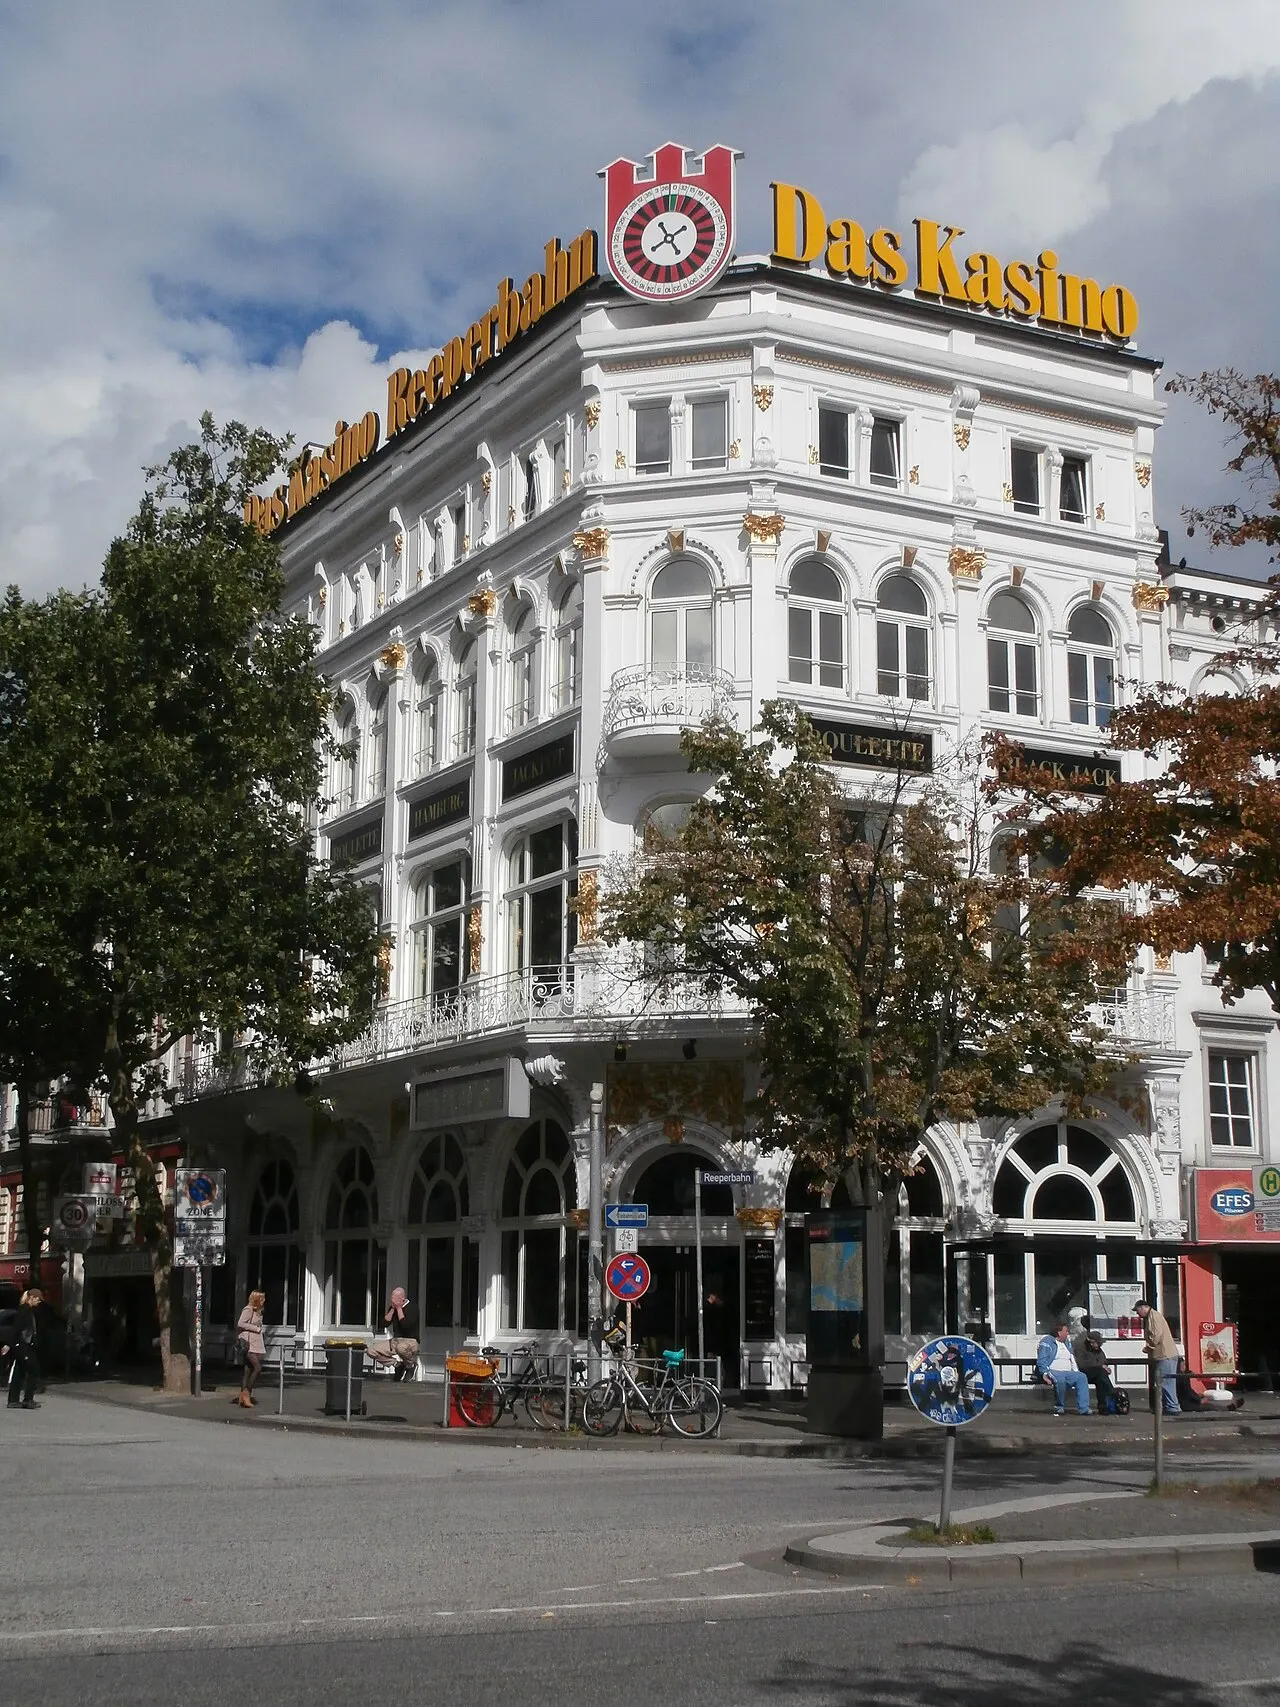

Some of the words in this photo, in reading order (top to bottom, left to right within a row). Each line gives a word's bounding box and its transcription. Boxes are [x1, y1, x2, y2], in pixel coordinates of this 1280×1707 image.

[770, 181, 908, 287] Das
[912, 217, 1139, 339] Kasino
[387, 229, 598, 440] Reeperbahn
[812, 729, 925, 762] OULETTE
[414, 791, 464, 828] HAMBURG
[704, 1172, 751, 1184] Reeperbahn
[1216, 1193, 1251, 1207] EFES
[66, 1209, 82, 1221] 30
[188, 1207, 213, 1217] ZONE
[14, 1265, 30, 1274] ROT
